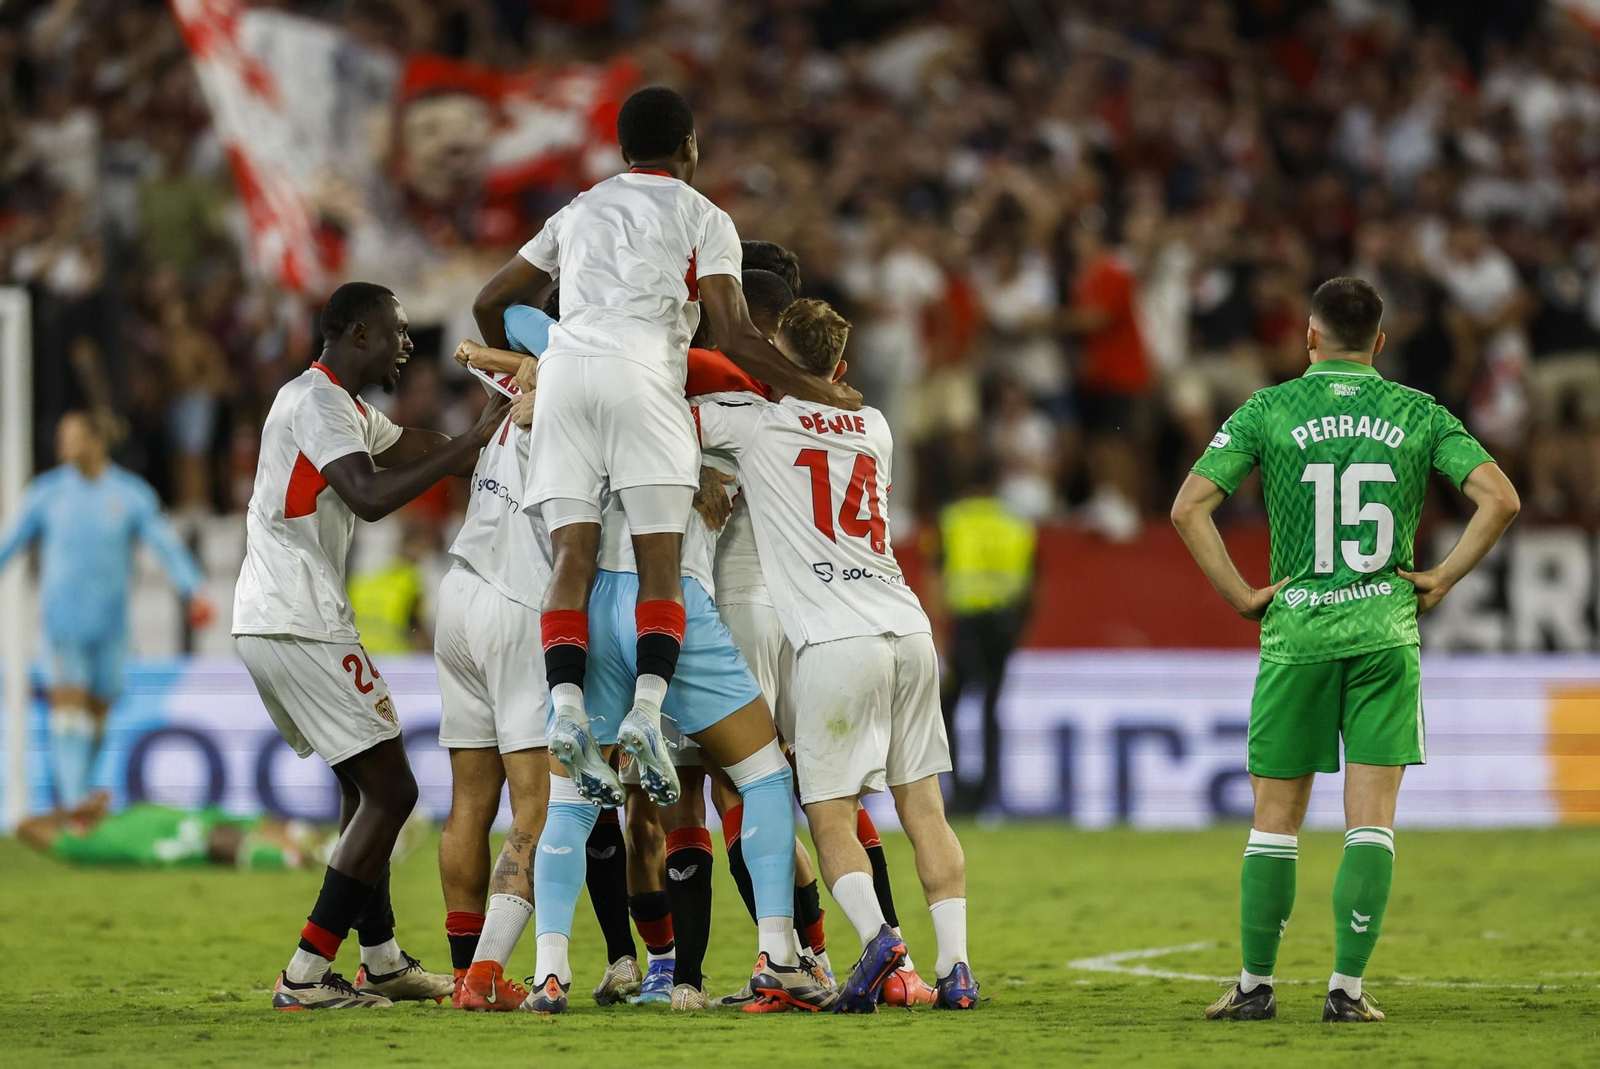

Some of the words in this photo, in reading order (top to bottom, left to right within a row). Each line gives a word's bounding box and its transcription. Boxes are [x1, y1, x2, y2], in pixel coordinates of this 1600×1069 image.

[1329, 382, 1361, 391] FOREVER
[1291, 415, 1405, 450] PERRAUD
[793, 449, 886, 555] 14
[1300, 462, 1398, 574] 15
[1309, 581, 1392, 607] trainline
